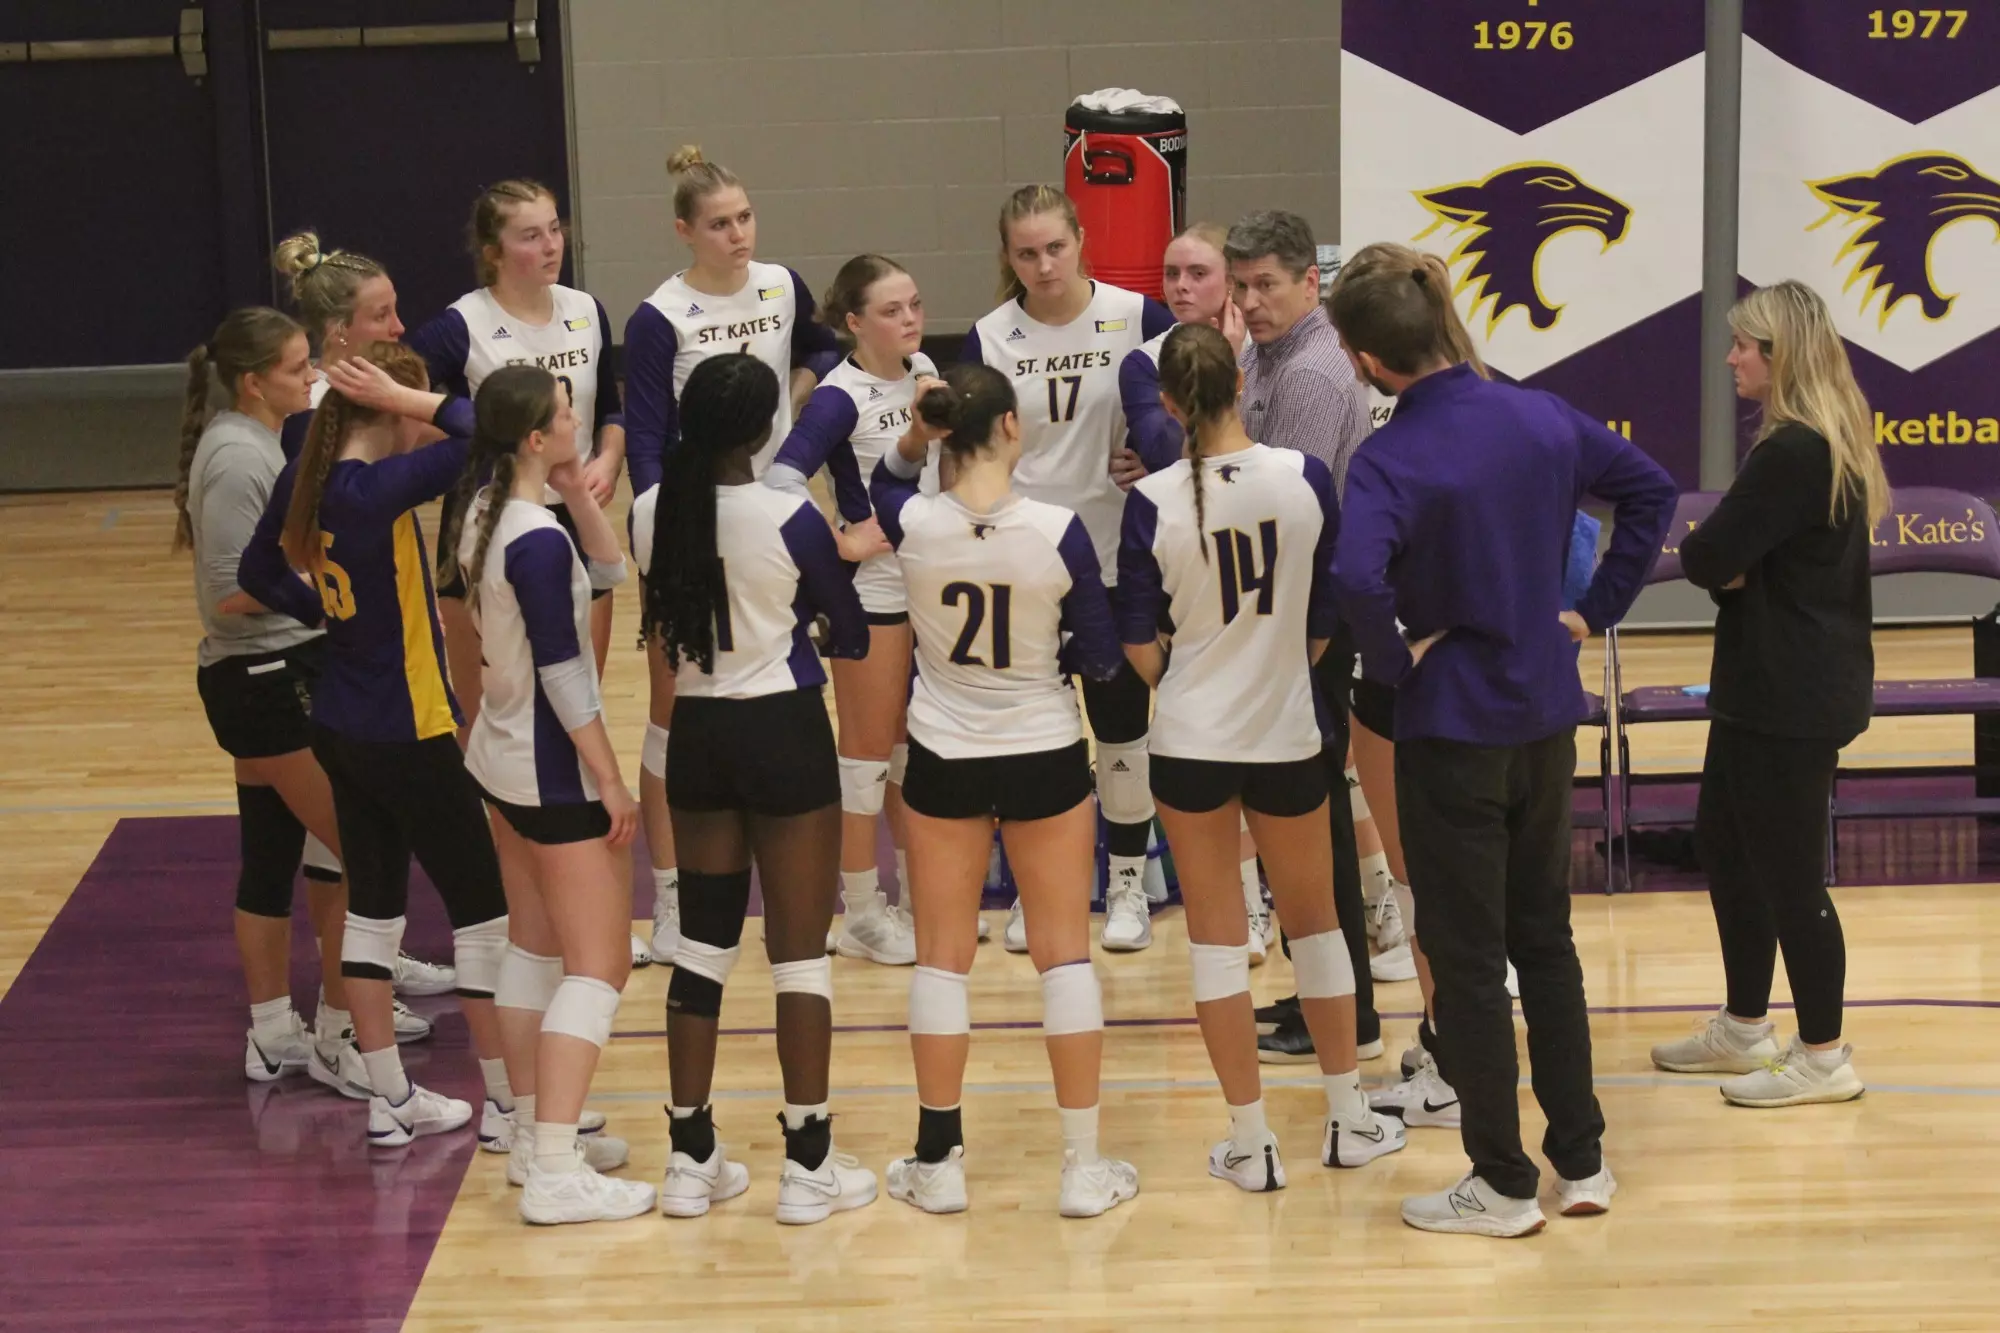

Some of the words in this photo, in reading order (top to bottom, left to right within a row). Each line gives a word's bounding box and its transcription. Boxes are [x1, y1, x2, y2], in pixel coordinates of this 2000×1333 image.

[1473, 20, 1574, 50] 1976
[1867, 9, 1968, 39] 1977
[699, 326, 722, 344] ST.
[727, 315, 781, 339] KATE'S
[536, 347, 589, 370] KATE'S
[1015, 358, 1039, 376] ST.
[1046, 350, 1111, 372] KATE'S
[1047, 375, 1082, 423] 17
[879, 412, 900, 430] ST.
[1895, 508, 1985, 546] Kate's
[1209, 517, 1279, 625] 14
[941, 580, 1012, 670] 21
